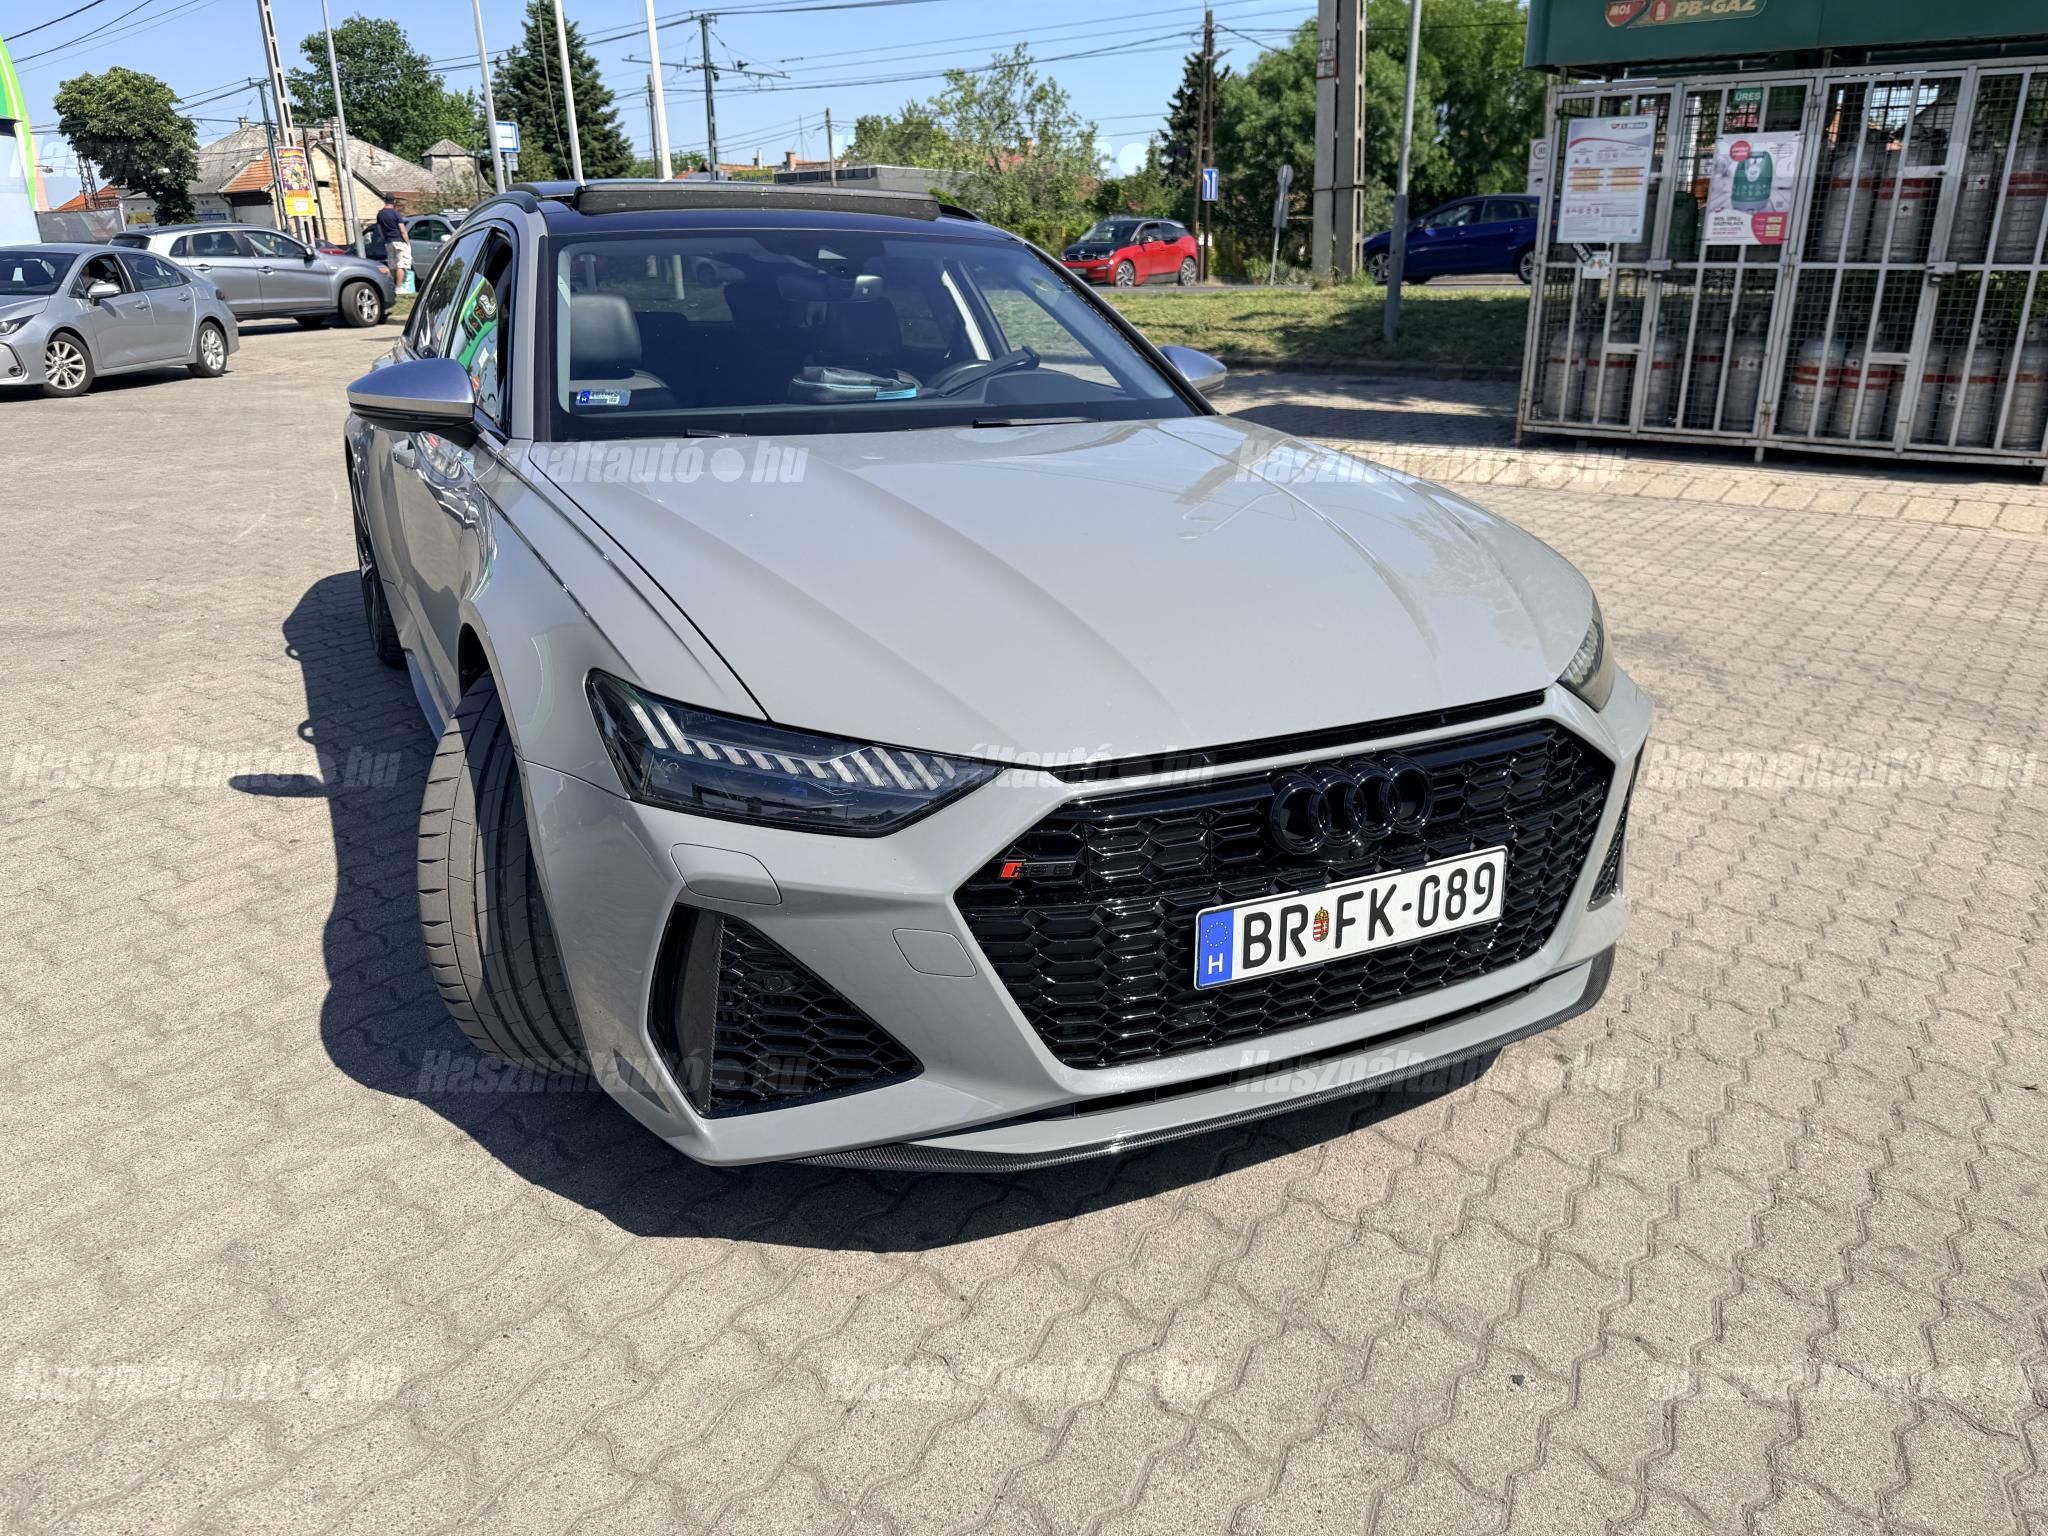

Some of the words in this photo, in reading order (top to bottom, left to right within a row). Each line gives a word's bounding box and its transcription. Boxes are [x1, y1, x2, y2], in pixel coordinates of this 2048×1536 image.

[1207, 952, 1224, 975] H
[1242, 903, 1309, 970] BR
[1334, 861, 1497, 950] FK-089
